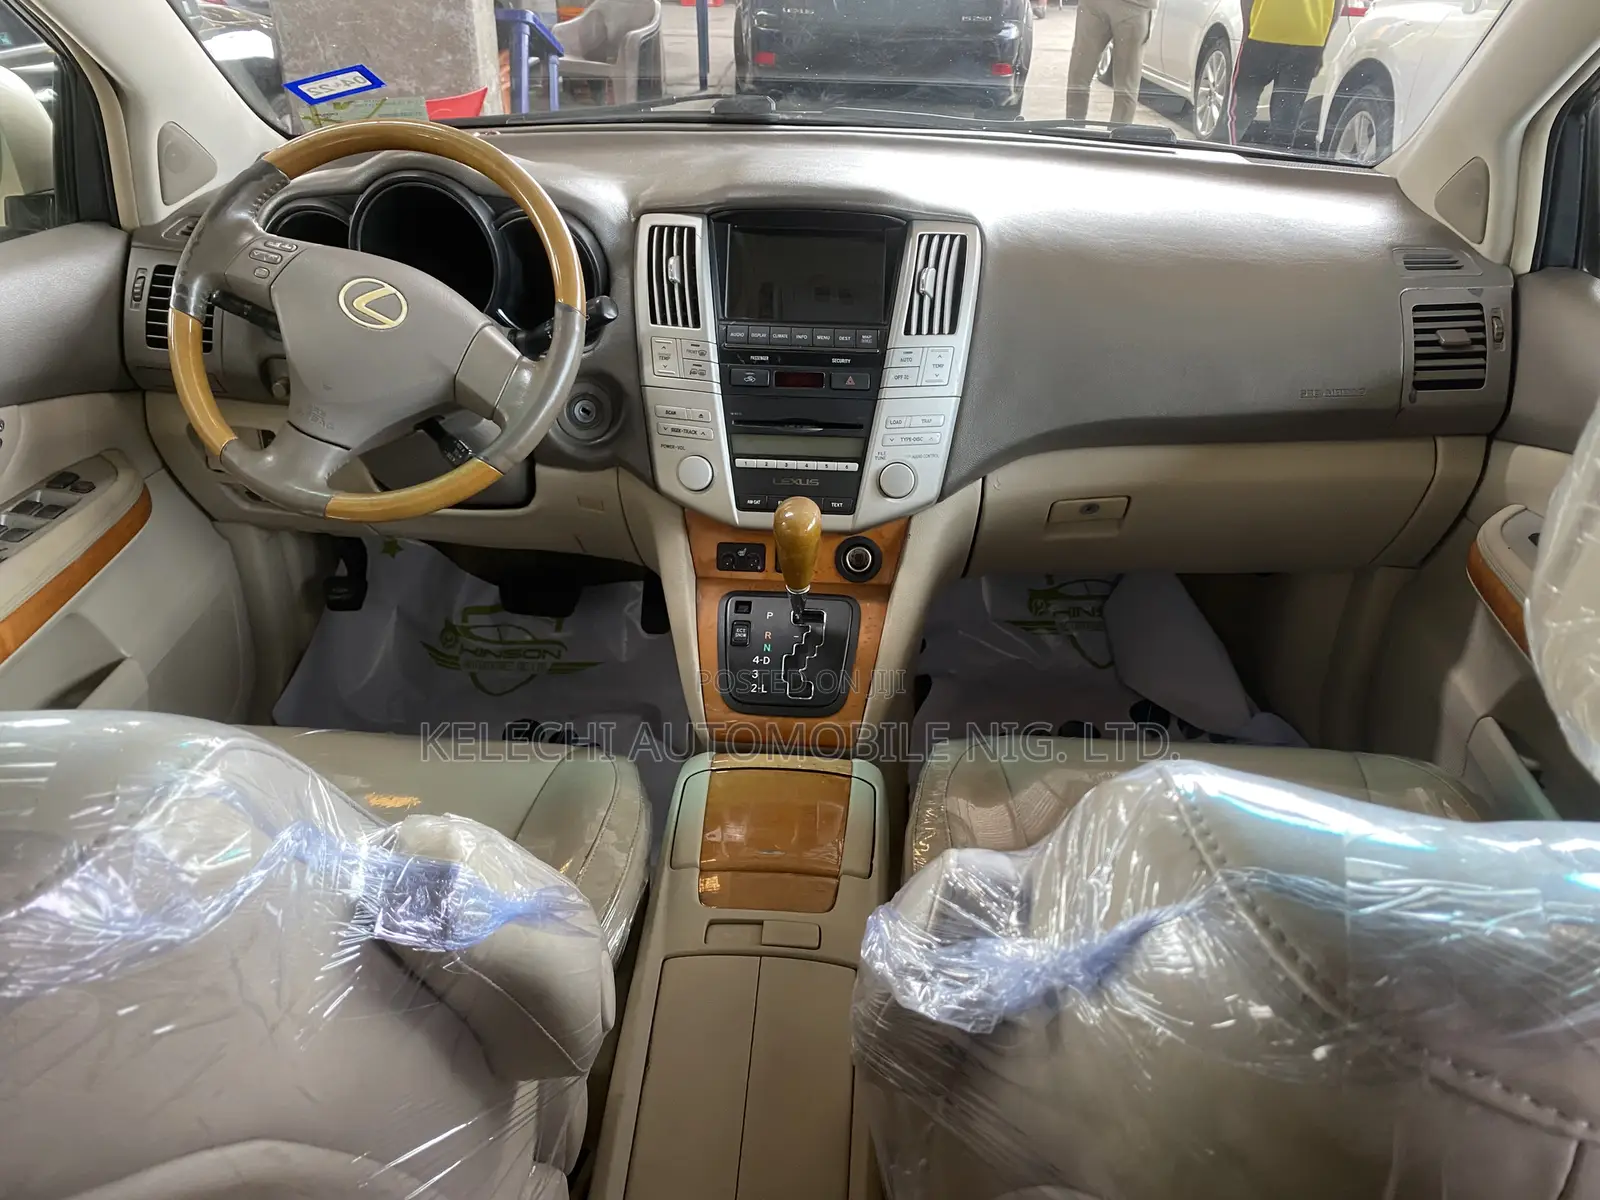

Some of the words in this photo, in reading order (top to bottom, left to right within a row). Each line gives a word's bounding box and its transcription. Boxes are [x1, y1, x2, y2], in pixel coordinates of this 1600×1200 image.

[773, 477, 820, 486] LEXUS
[766, 611, 774, 620] P
[764, 631, 772, 639] R
[763, 643, 771, 652] N
[751, 670, 759, 679] 3
